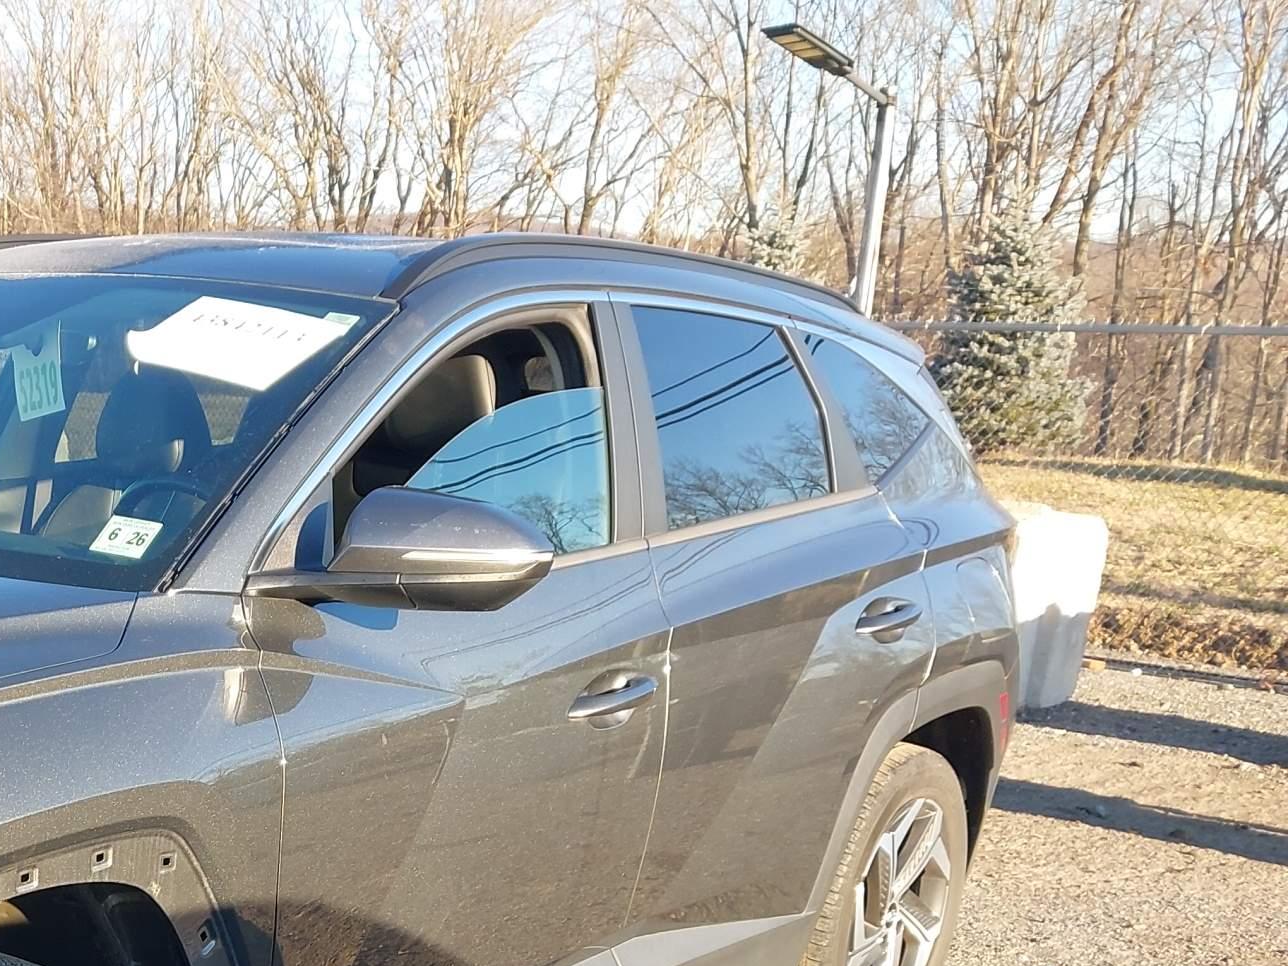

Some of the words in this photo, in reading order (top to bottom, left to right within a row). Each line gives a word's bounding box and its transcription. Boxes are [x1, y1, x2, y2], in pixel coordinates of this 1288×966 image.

[18, 360, 59, 414] 52319
[108, 527, 123, 541] 6
[126, 531, 149, 547] 26
